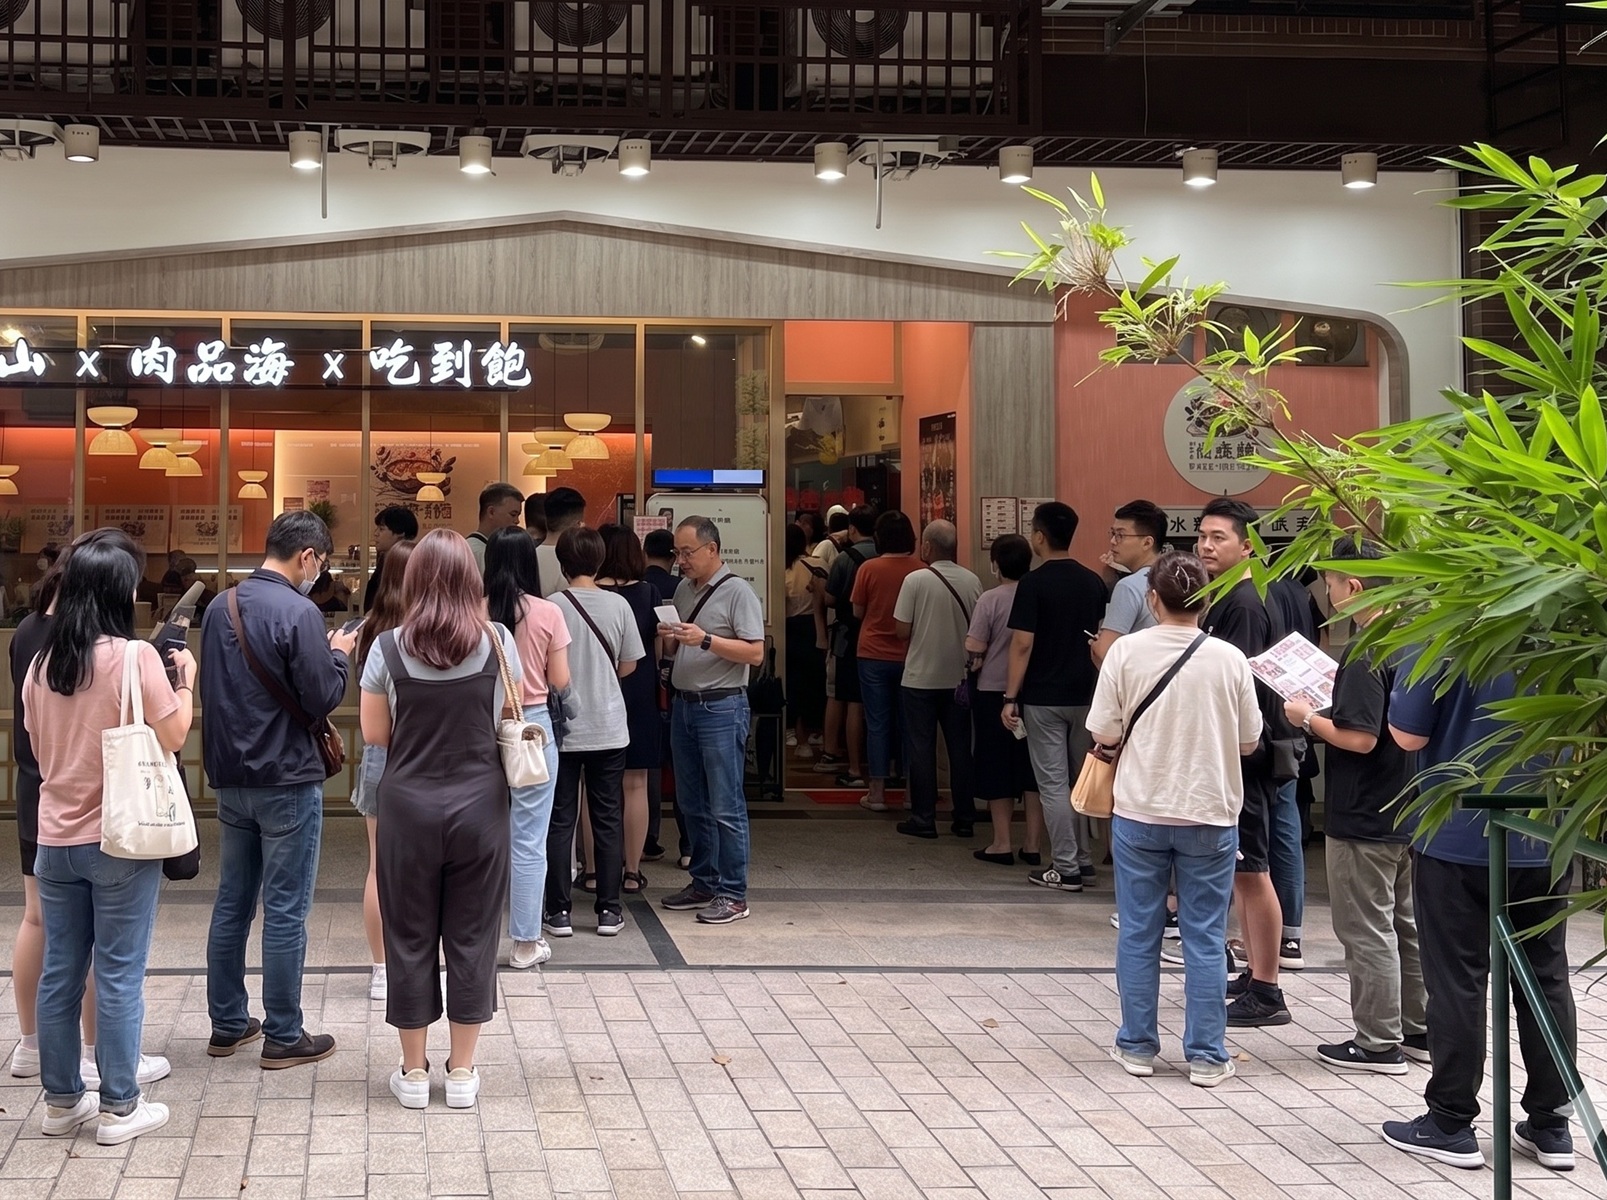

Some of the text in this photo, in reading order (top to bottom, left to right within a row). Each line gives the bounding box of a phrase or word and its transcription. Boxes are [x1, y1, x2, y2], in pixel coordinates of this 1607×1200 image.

[0, 338, 46, 378] 山
[131, 336, 295, 386] 肉品海
[369, 338, 532, 387] 吃到飽
